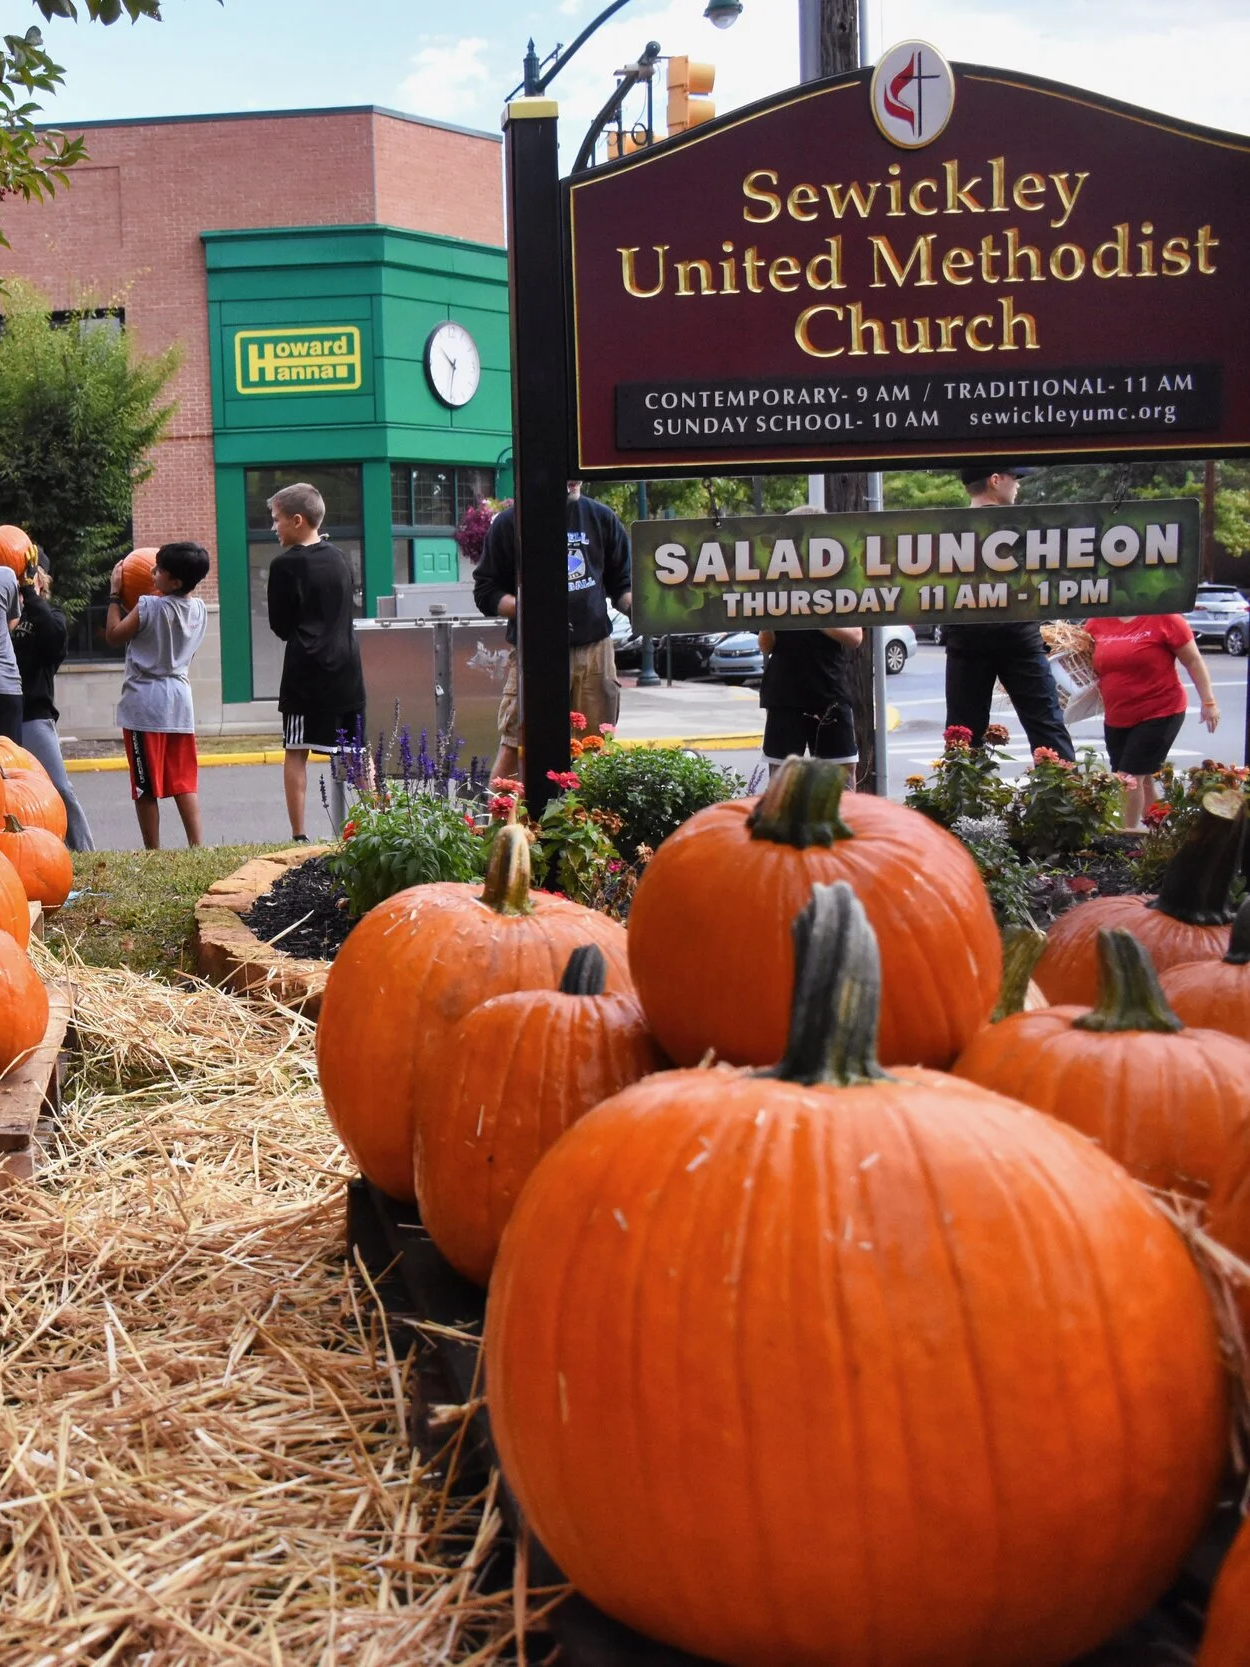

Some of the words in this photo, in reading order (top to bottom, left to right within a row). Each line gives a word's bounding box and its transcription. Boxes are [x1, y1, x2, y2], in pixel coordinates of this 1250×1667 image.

[743, 157, 1090, 228] Sewickley
[616, 235, 846, 298] United
[868, 222, 1219, 287] Methodist
[794, 297, 1040, 359] Church
[248, 335, 347, 381] Howard
[248, 344, 334, 381] Hanna
[645, 387, 848, 409] CONTEMPORARY-
[856, 386, 868, 403] 9
[876, 385, 911, 401] AM
[944, 378, 1115, 399] TRADITIONAL-
[1125, 376, 1147, 393] 11
[1158, 374, 1193, 392] AM
[653, 417, 748, 435] SUNDAY
[756, 413, 863, 432] SCHOOL-
[873, 412, 897, 428] 10
[905, 411, 939, 427] AM
[970, 405, 1176, 427] sewickleyumc.org
[654, 537, 845, 585] SALAD
[865, 523, 1179, 576] LUNCHEON
[722, 587, 900, 617] THURSDAY
[919, 586, 945, 610] 11
[952, 582, 1008, 609] AM
[1037, 581, 1049, 606] 1
[1060, 579, 1109, 605] PM
